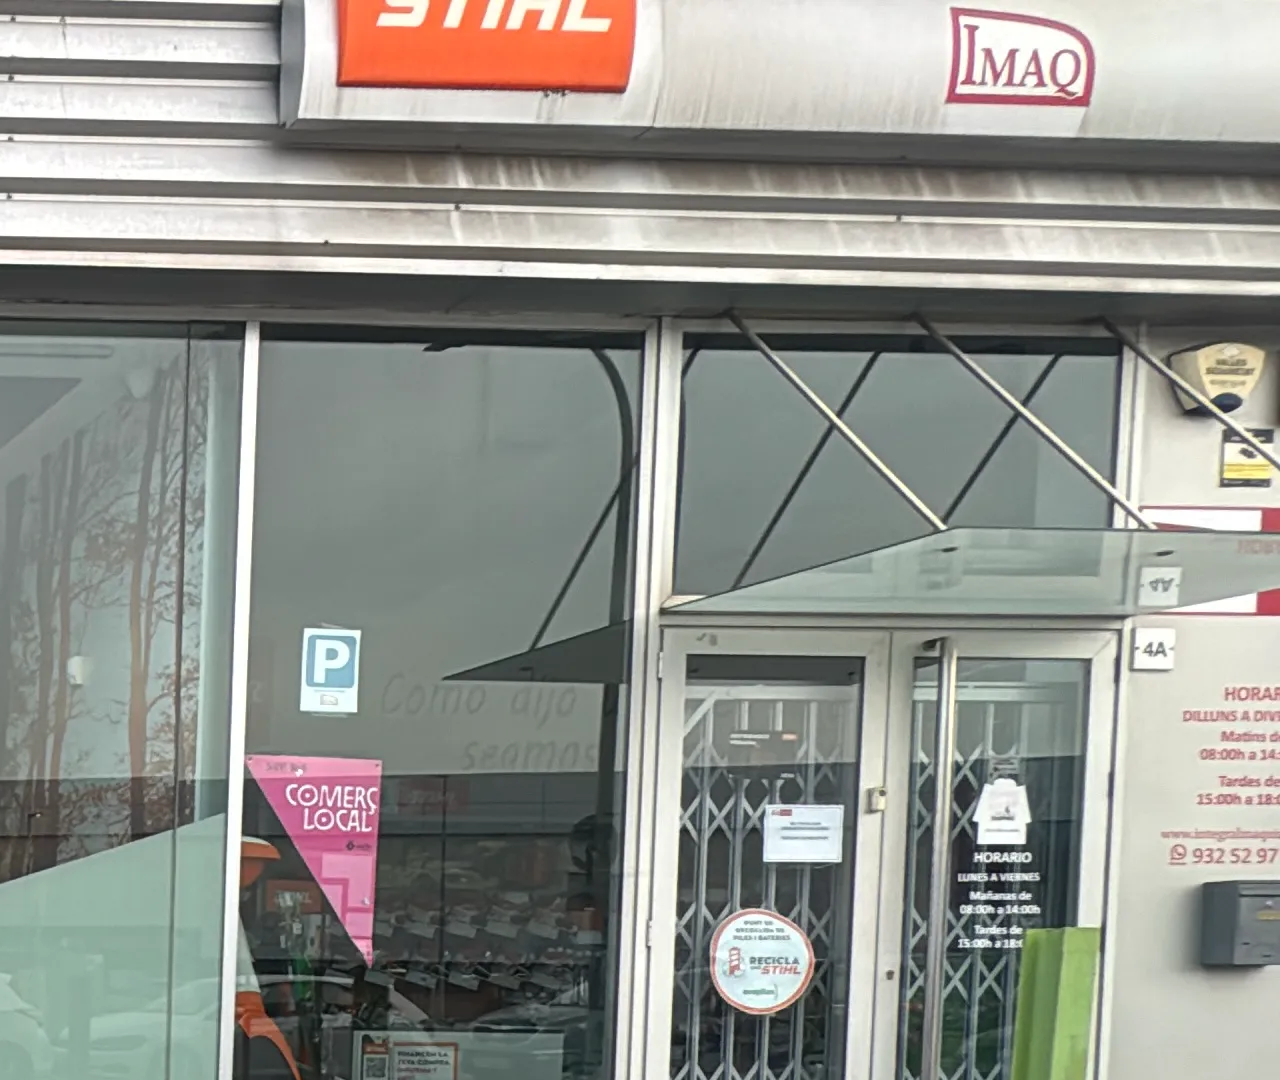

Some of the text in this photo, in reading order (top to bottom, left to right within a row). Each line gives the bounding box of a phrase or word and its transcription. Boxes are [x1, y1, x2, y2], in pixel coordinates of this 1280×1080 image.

[1142, 641, 1167, 657] 4A
[313, 638, 350, 684] P
[381, 673, 487, 716] Como
[1182, 710, 1237, 722] DILLUNS
[1241, 710, 1251, 722] A
[1220, 731, 1266, 742] Matins
[1200, 748, 1245, 760] 08:00h
[1248, 750, 1257, 760] a
[1218, 776, 1261, 787] Tardes
[286, 783, 379, 815] COMERÇ
[1196, 793, 1242, 805] 15:00h
[1245, 796, 1253, 805] a
[303, 808, 373, 832] LOCAL
[973, 852, 1033, 863] HORARIO
[1192, 848, 1279, 864] 932 52 97
[957, 872, 1041, 882] LUNES A VIERNES
[969, 890, 1032, 900] Mañanas de
[997, 906, 1004, 914] a
[974, 925, 1023, 935] Tardes de
[749, 956, 800, 965] RECICLA
[761, 965, 801, 975] STIHL
